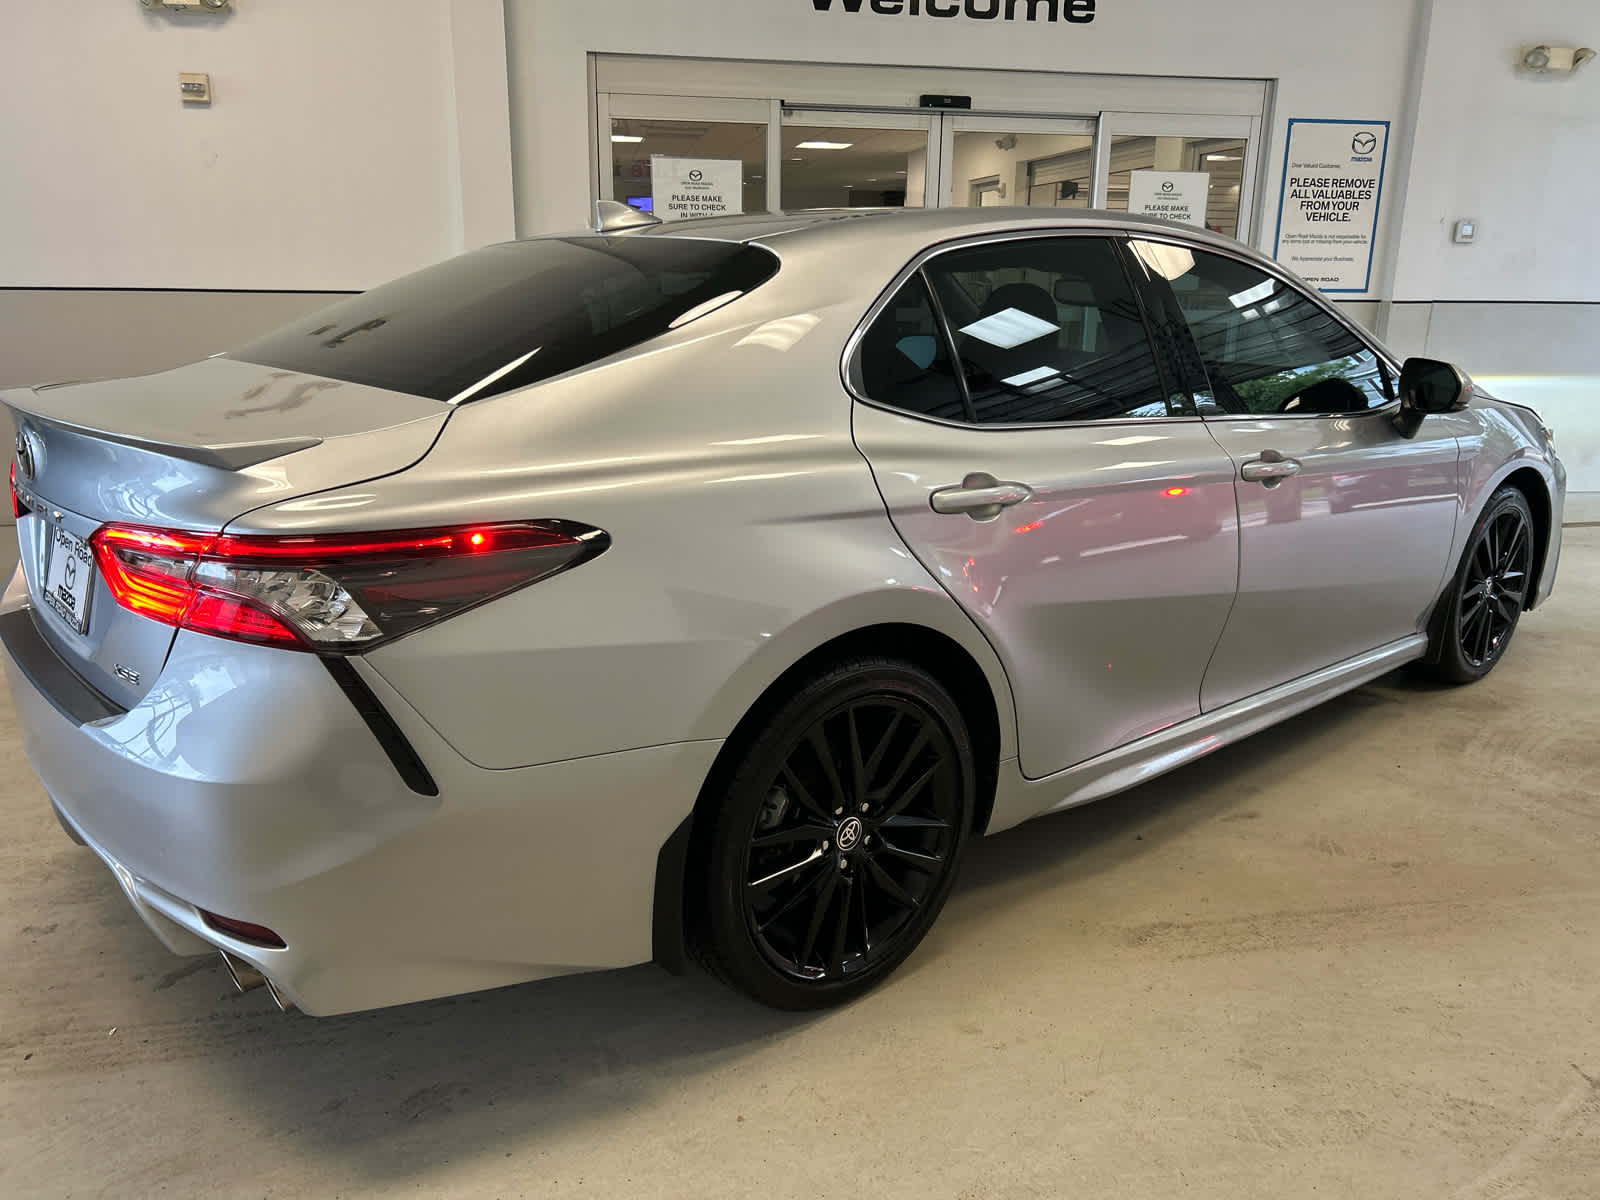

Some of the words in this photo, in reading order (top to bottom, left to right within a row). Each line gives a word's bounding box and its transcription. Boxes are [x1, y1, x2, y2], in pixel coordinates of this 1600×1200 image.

[1290, 177, 1330, 188] PLEASE
[1331, 178, 1375, 189] REMOVE
[672, 194, 700, 202] PLEASE
[702, 195, 722, 203] MAKE
[1290, 189, 1310, 199] ALL
[1311, 189, 1372, 200] VALUABLES
[1144, 204, 1169, 212] PLEASE
[1300, 200, 1331, 210] FROM
[1331, 201, 1360, 211] YOUR
[1305, 212, 1351, 222] VEHICLE.
[55, 528, 73, 552] Open
[74, 542, 92, 567] Road
[112, 663, 140, 685] XSE
